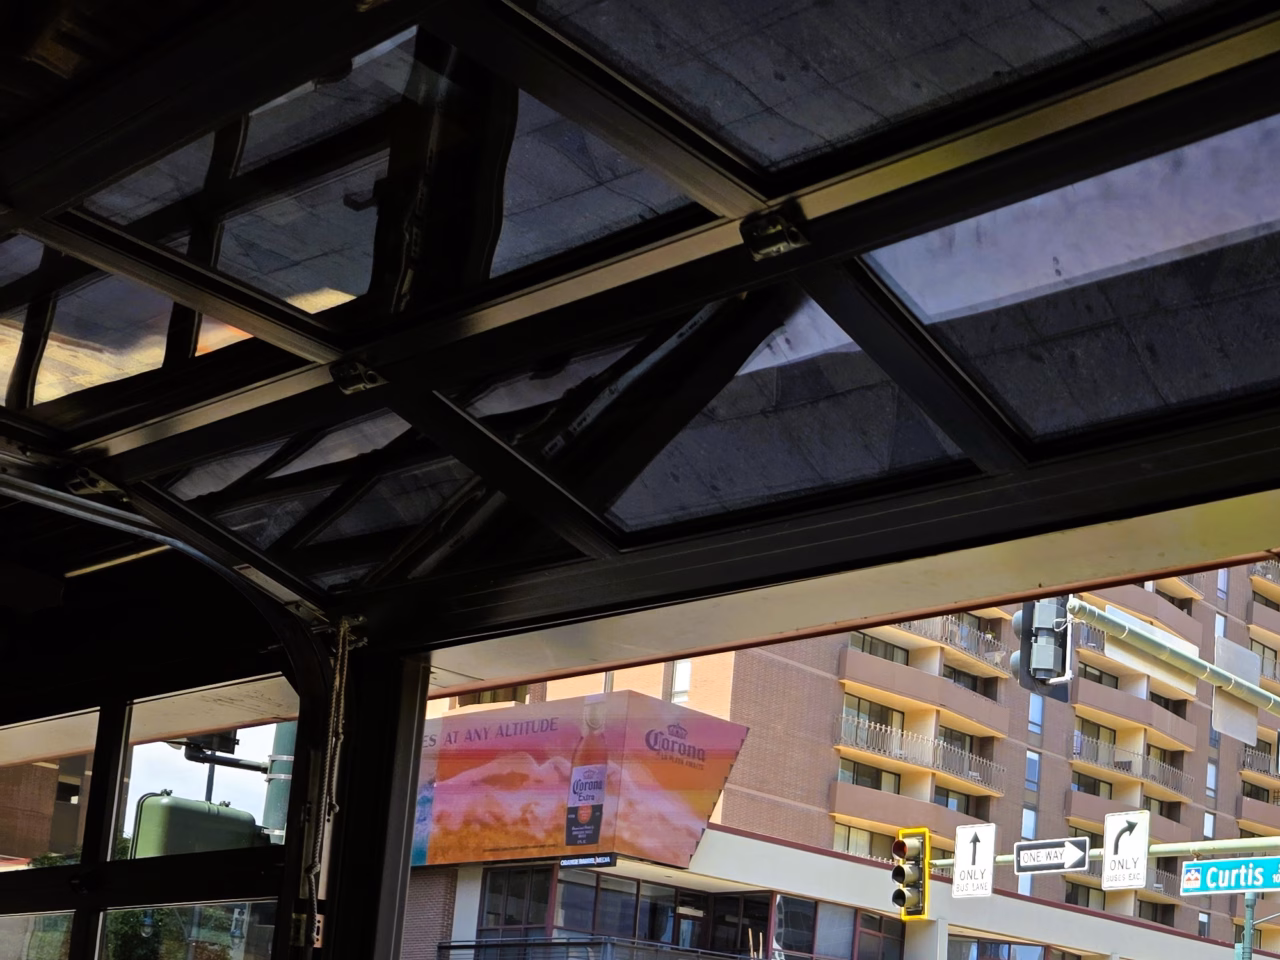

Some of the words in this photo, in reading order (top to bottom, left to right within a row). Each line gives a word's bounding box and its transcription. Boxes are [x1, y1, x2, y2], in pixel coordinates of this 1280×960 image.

[444, 731, 459, 745] AT
[465, 727, 490, 742] ANY
[495, 717, 559, 738] ALTITUDE
[645, 729, 705, 762] Corona
[572, 779, 603, 795] Corona
[578, 793, 595, 802] Extra
[1022, 852, 1041, 864] ONE
[1045, 850, 1064, 862] WAY
[1110, 857, 1139, 871] ONLY
[959, 869, 986, 881] ONLY
[1206, 863, 1264, 888] Curtis
[956, 883, 968, 892] BUS
[972, 882, 988, 892] LANE
